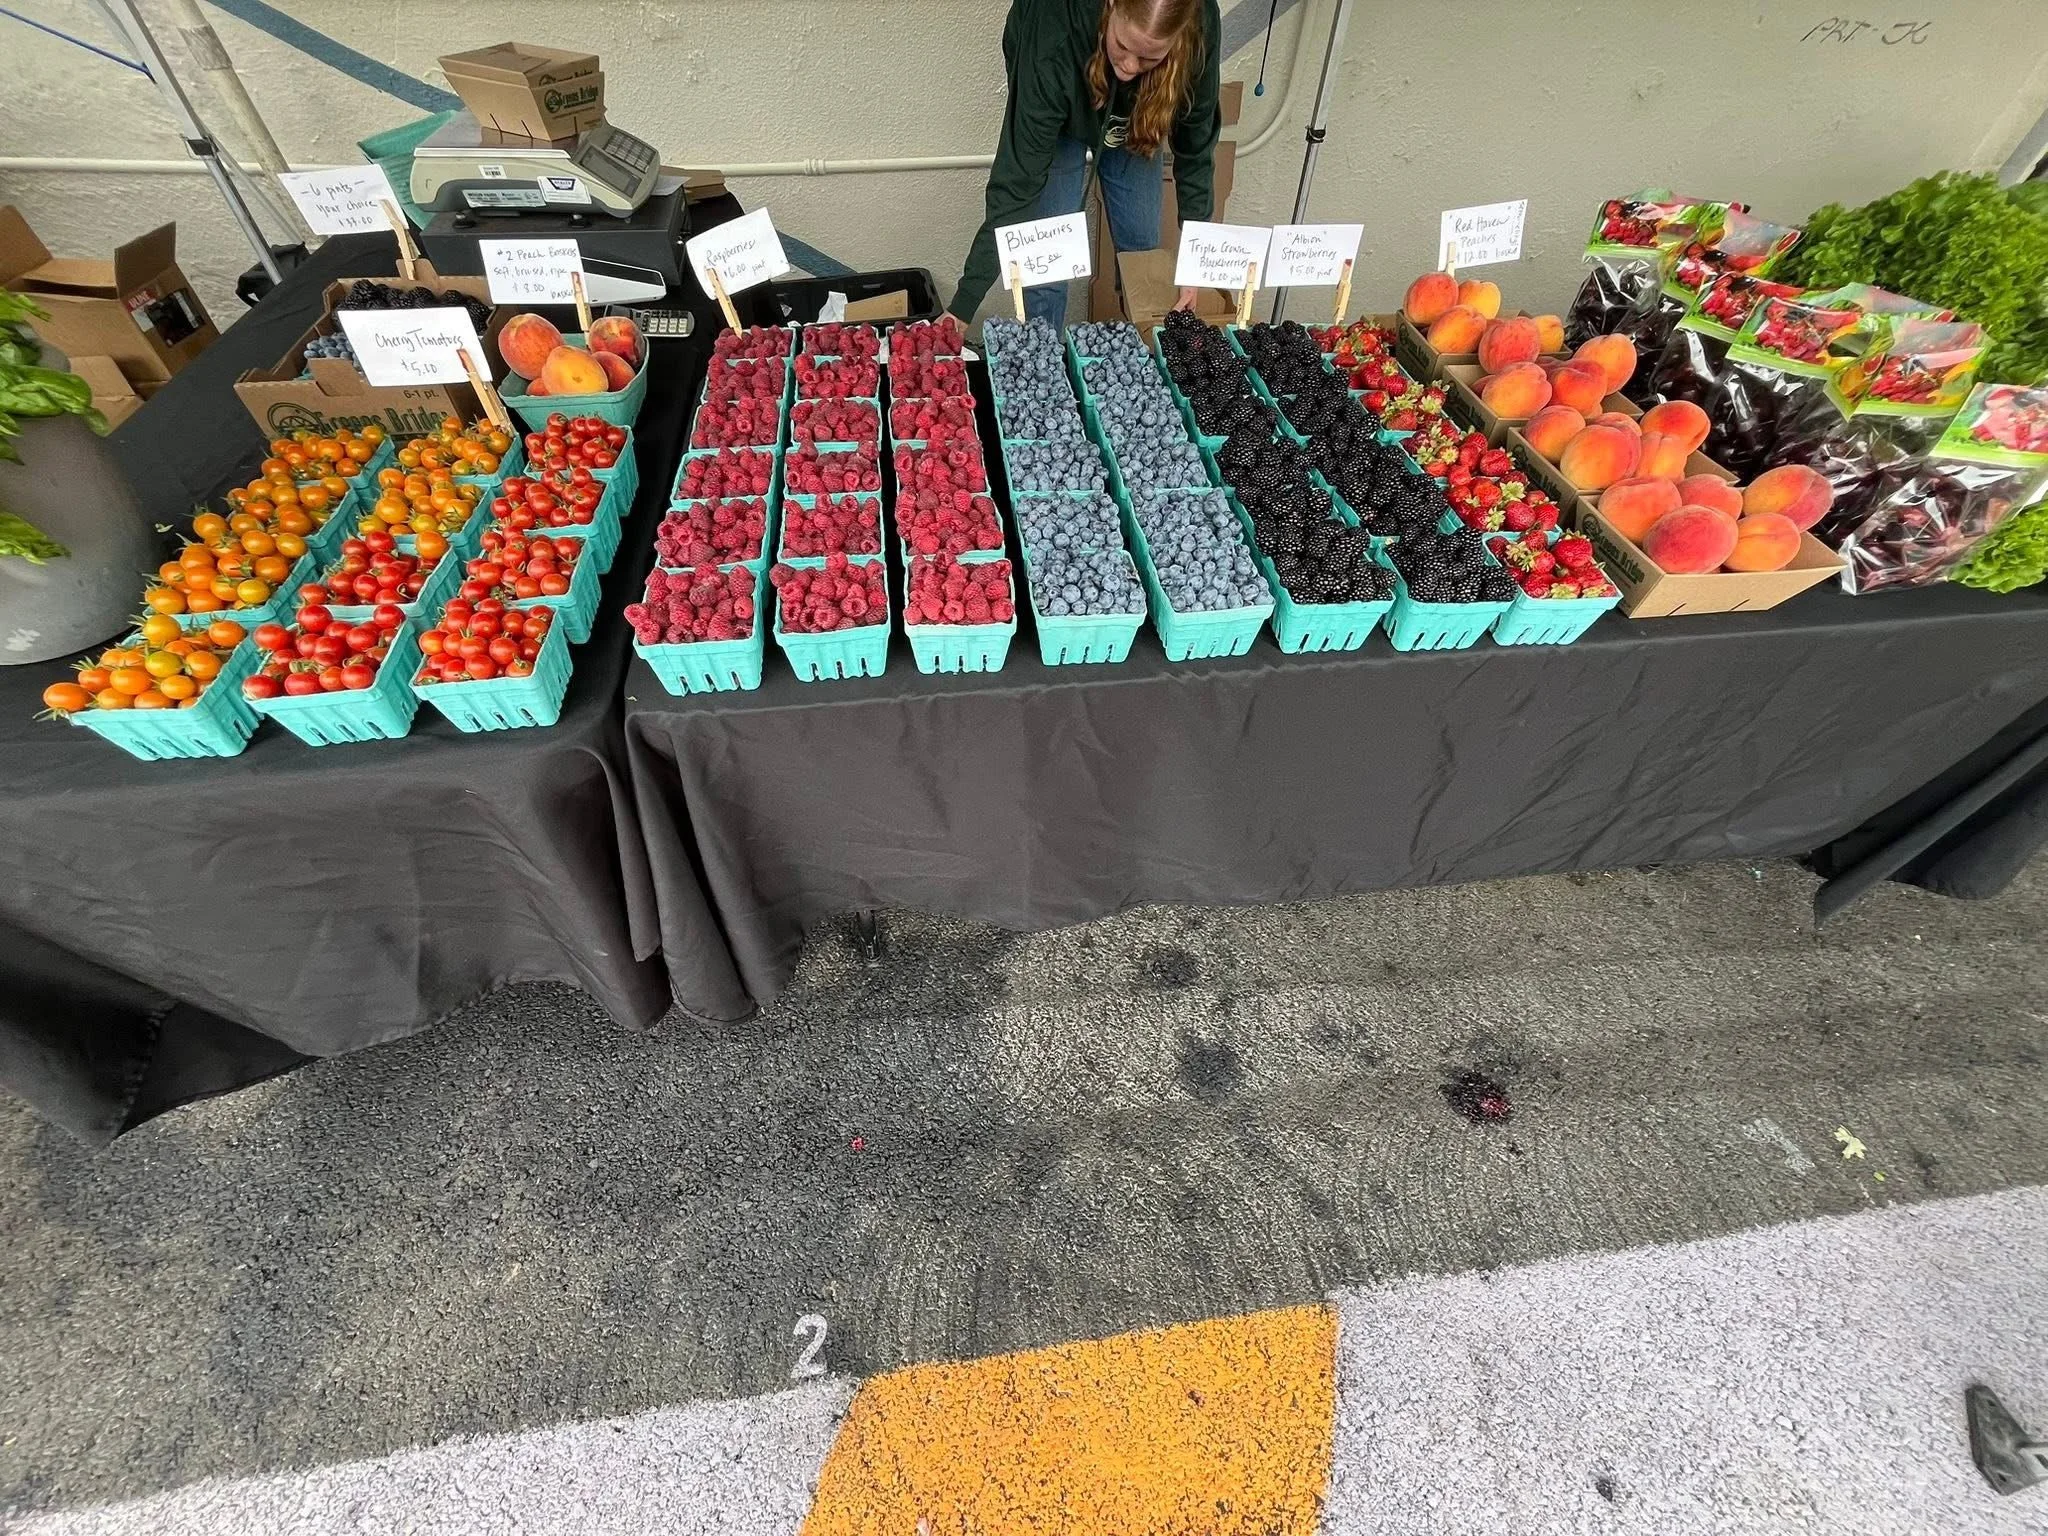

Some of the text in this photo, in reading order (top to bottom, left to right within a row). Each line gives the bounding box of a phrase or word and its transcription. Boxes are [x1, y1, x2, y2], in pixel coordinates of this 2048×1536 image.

[347, 199, 378, 211] choice
[1005, 223, 1073, 252] Blueberries
[1460, 233, 1497, 249] Peaches
[516, 248, 545, 261] Peach
[706, 239, 756, 267] Raspberries
[1188, 238, 1251, 258] Triple Crown
[1281, 247, 1337, 261] Strawberries
[1199, 256, 1249, 269] Blackberries
[375, 328, 464, 352] Cherry Tomatoes
[403, 389, 421, 399] 6-1
[791, 1313, 828, 1379] 2
